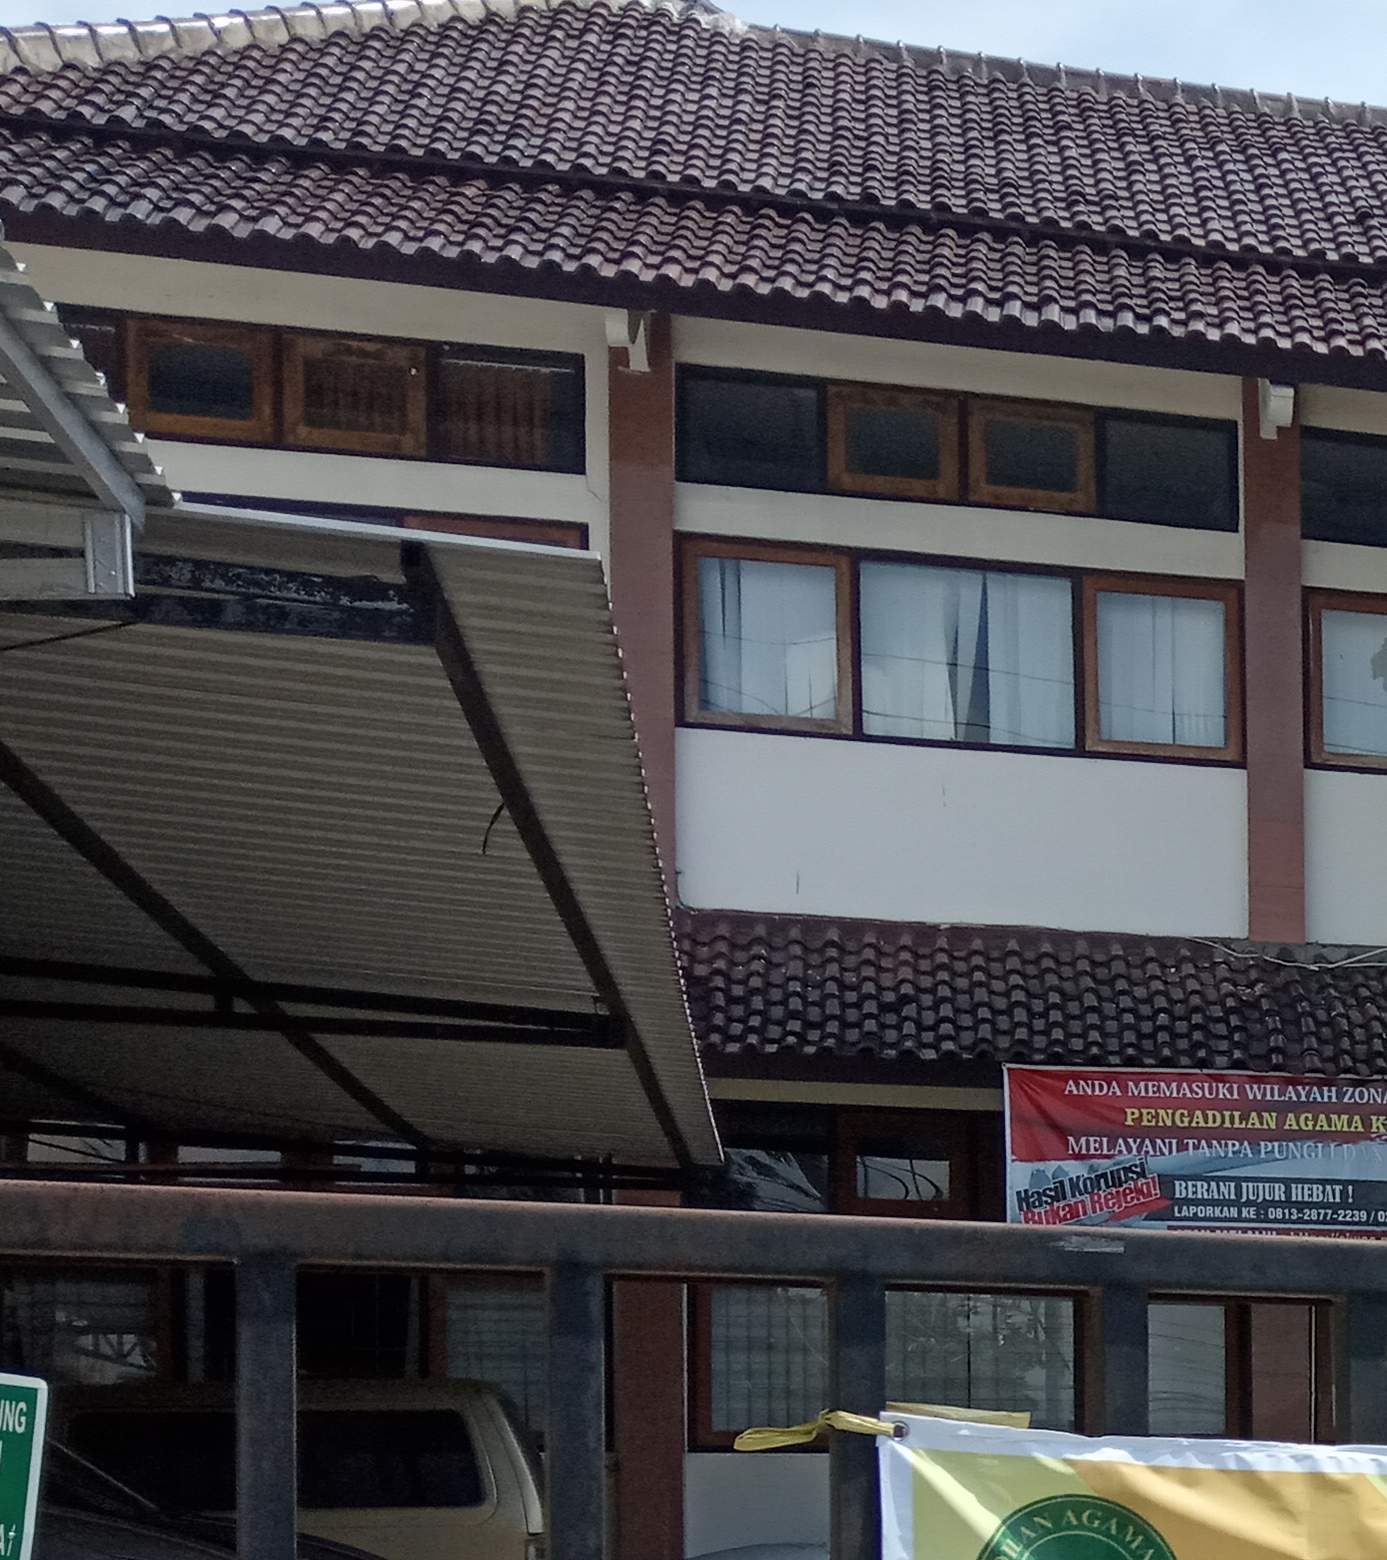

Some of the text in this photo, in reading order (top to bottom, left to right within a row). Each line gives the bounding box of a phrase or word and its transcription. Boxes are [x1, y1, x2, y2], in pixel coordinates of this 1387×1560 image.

[1064, 1080, 1122, 1096] ANDA
[1127, 1081, 1240, 1099] MEMASUKI
[1244, 1083, 1339, 1103] WILAYAH
[1124, 1108, 1277, 1130] PENGADILAN
[1283, 1112, 1365, 1133] AGAMA
[1067, 1136, 1178, 1157] MELAYANI
[1183, 1139, 1252, 1159] TANPA
[1016, 1157, 1149, 1212] Hasil Korupsi
[1174, 1180, 1236, 1200] BERANI
[1240, 1182, 1286, 1202] JUJUR
[1291, 1184, 1343, 1203] HEBAT
[1022, 1175, 1161, 1226] Bukan Rejeki!
[1174, 1206, 1238, 1218] LAPORKAN
[1242, 1207, 1257, 1219] KE
[1267, 1207, 1368, 1222] 0813-2877-2239
